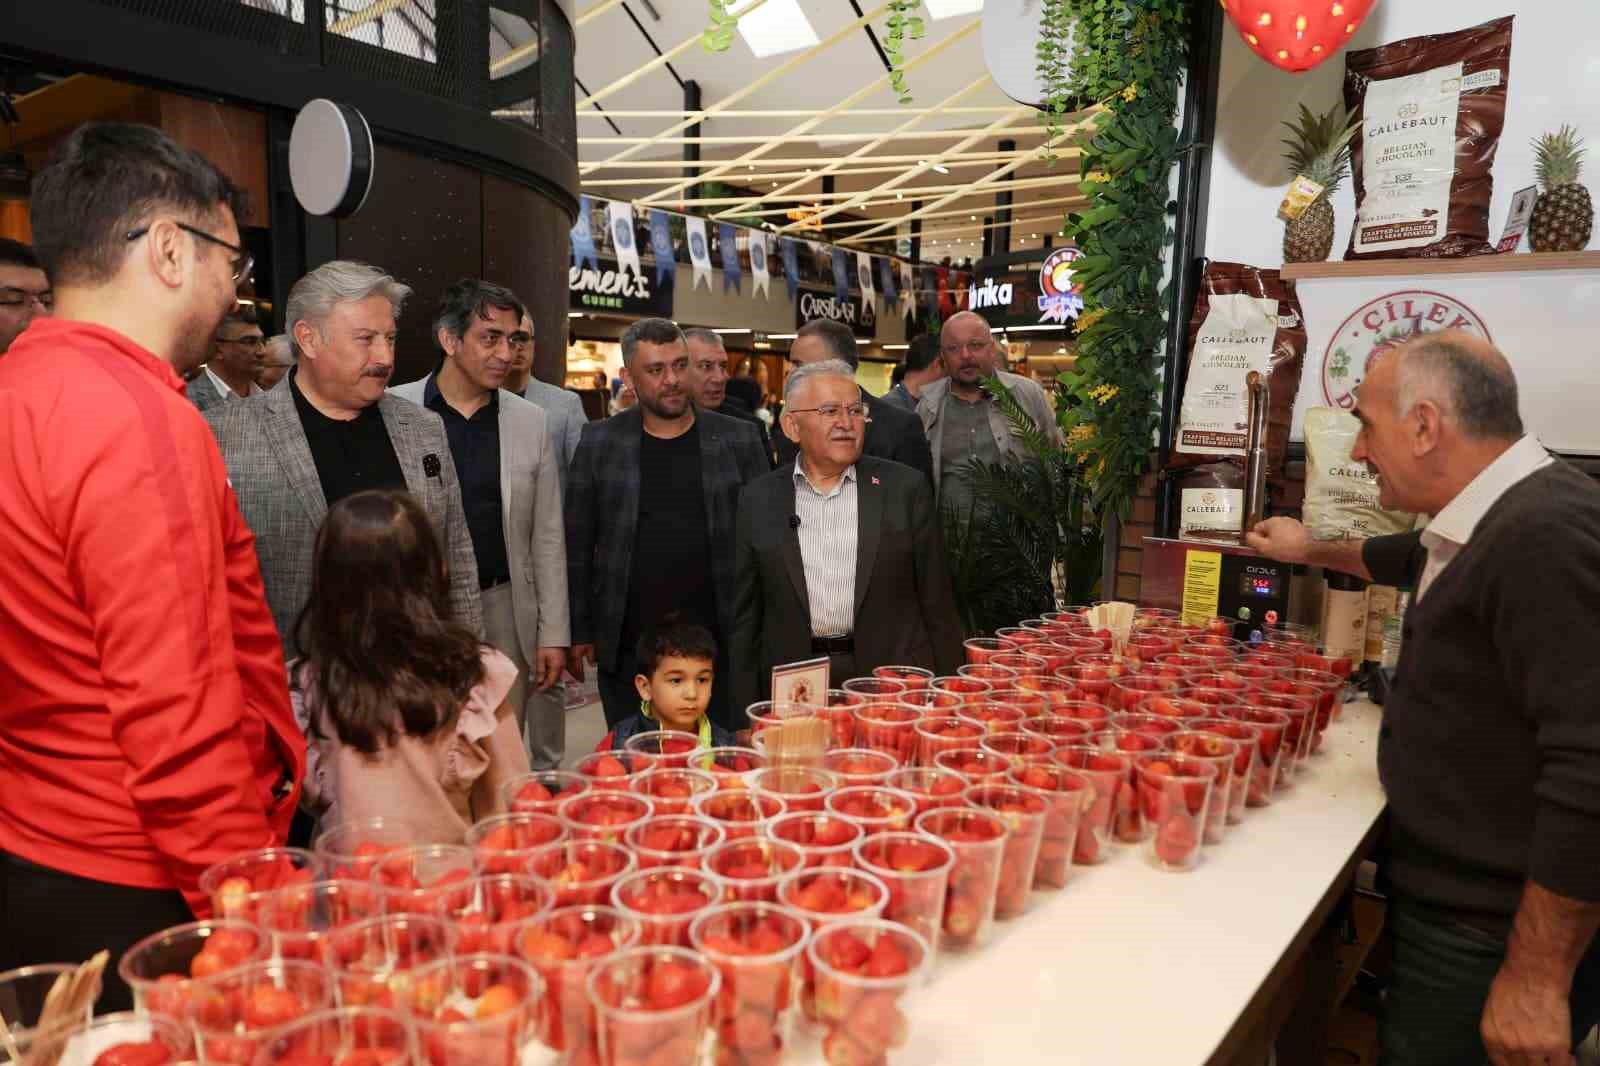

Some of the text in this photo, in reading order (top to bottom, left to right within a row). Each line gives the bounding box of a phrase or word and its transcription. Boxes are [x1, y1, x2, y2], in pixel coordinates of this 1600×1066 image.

[1368, 116, 1448, 137] CALLEBAUT
[1201, 336, 1267, 345] CALLEBAUT
[1328, 467, 1377, 480] CALLEB
